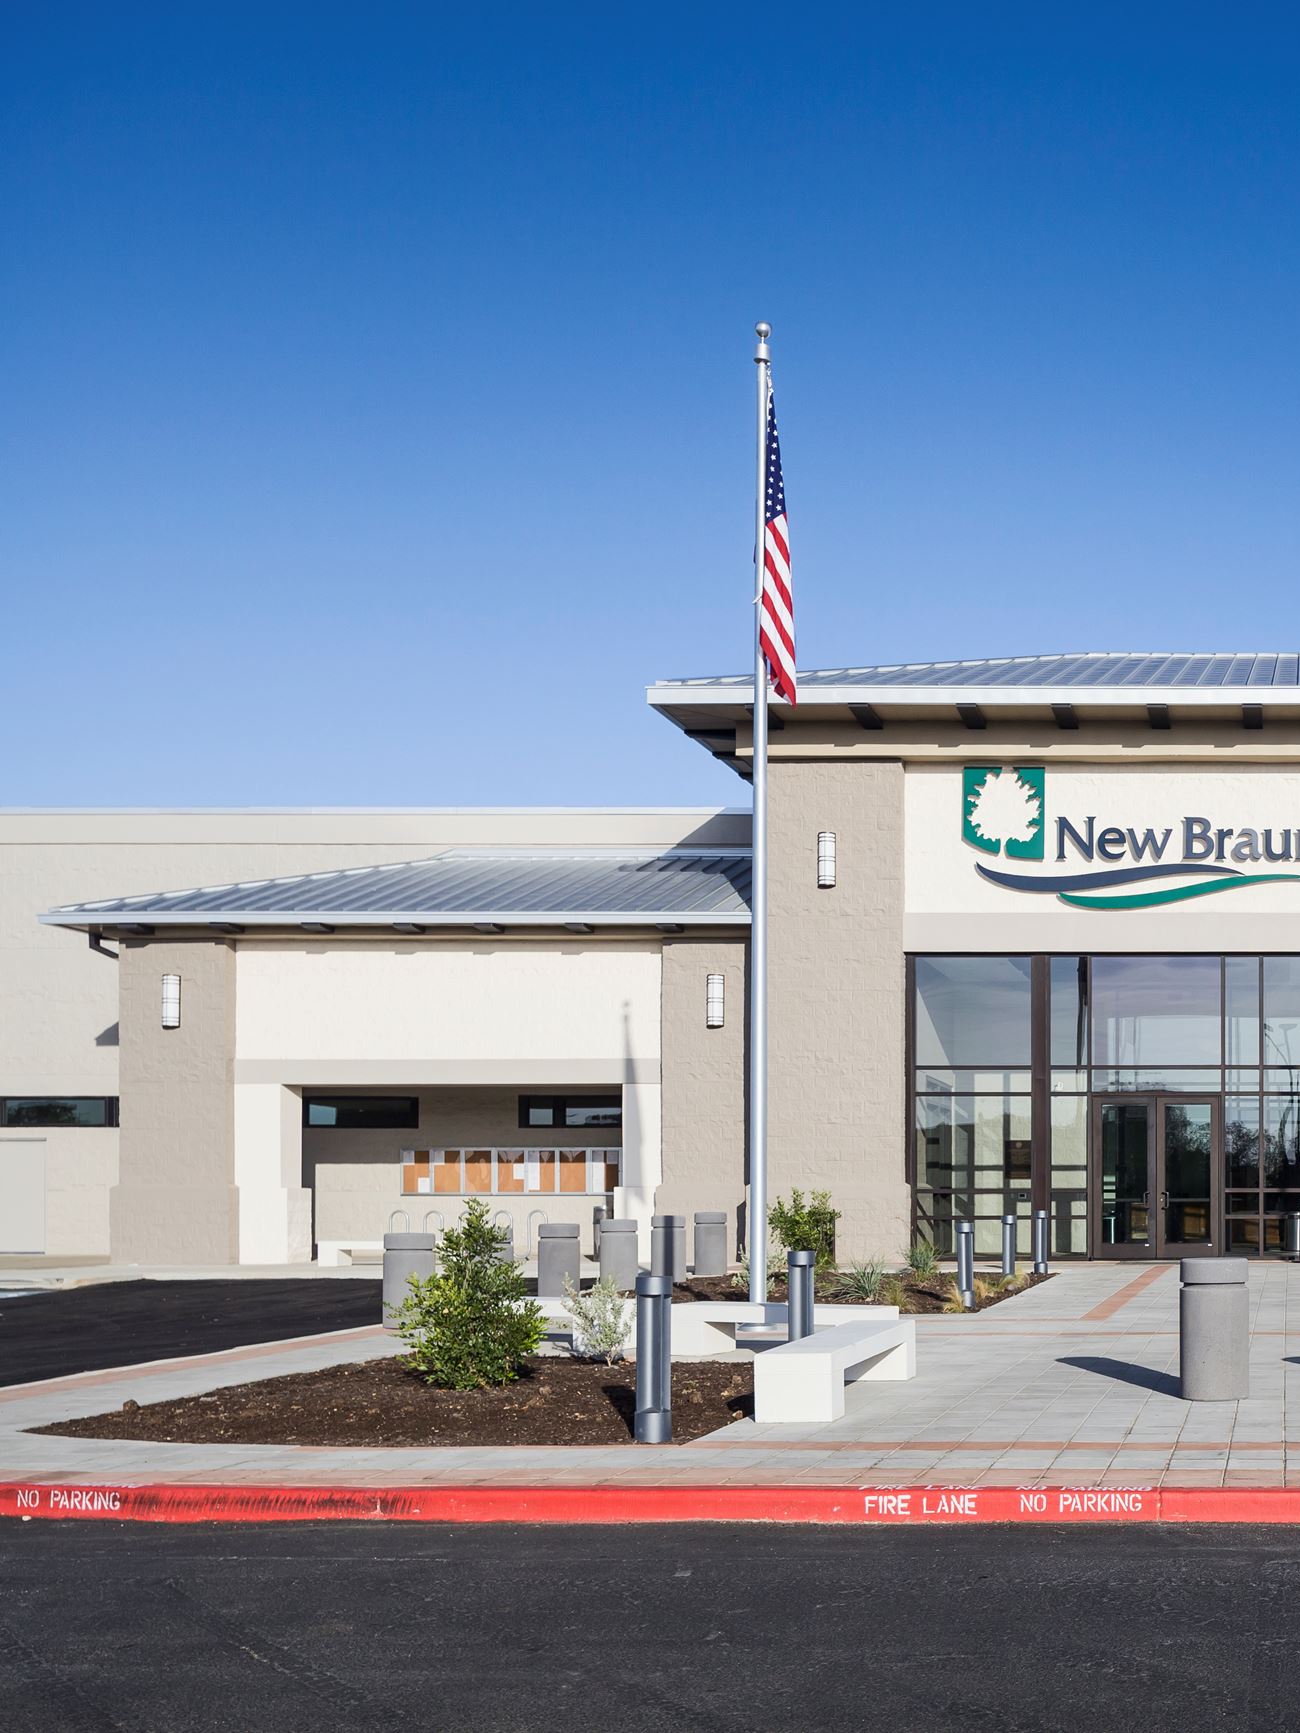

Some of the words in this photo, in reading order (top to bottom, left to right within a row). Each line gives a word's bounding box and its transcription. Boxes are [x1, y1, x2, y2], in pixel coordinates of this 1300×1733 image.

[1055, 815, 1173, 862] New
[17, 1489, 40, 1508] NO
[49, 1489, 120, 1511] PARKING
[864, 1494, 912, 1515] FIRE
[922, 1494, 978, 1515] LANE
[1020, 1493, 1047, 1513] NO
[1059, 1493, 1143, 1513] PARKING
